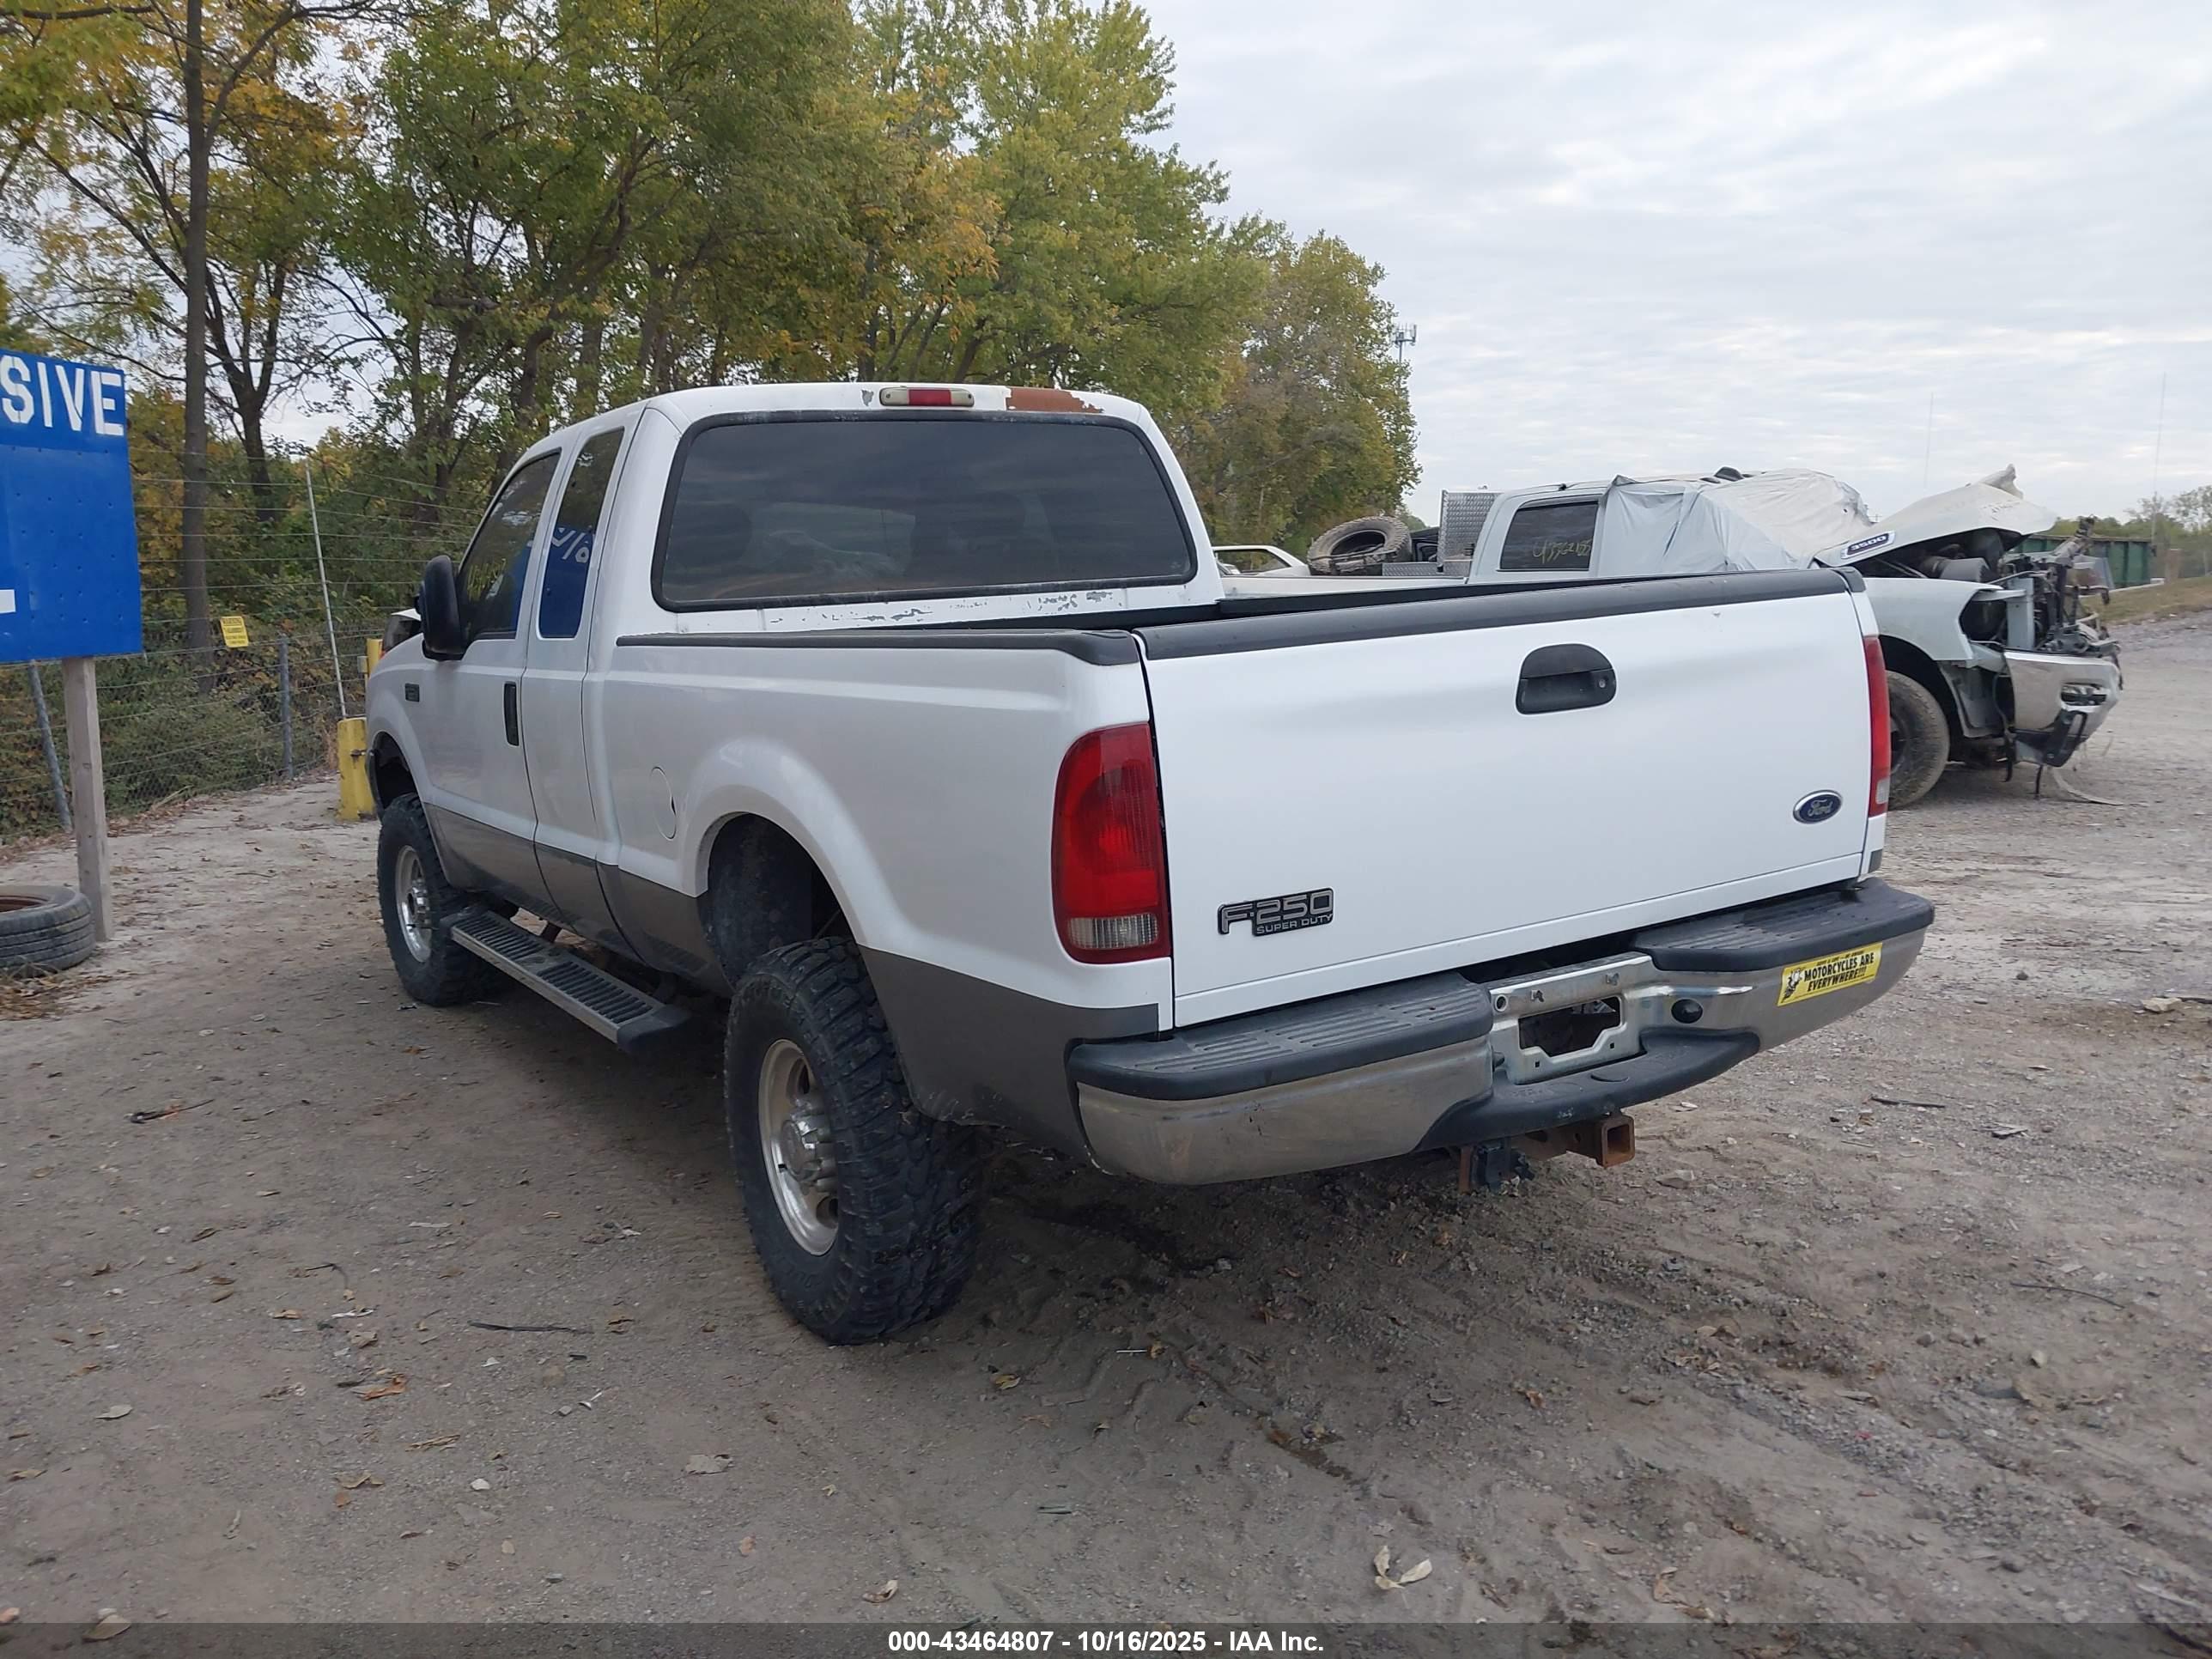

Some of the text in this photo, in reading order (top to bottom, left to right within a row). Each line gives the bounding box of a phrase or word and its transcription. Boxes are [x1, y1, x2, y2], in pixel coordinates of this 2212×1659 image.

[0, 355, 124, 436] SIVE
[1850, 535, 1887, 550] 3500
[1808, 799, 1833, 817] Ford
[1257, 914, 1333, 934] SUPER DUTY
[1804, 957, 1857, 981] MOTORCYCLES
[1859, 952, 1874, 966] ARE
